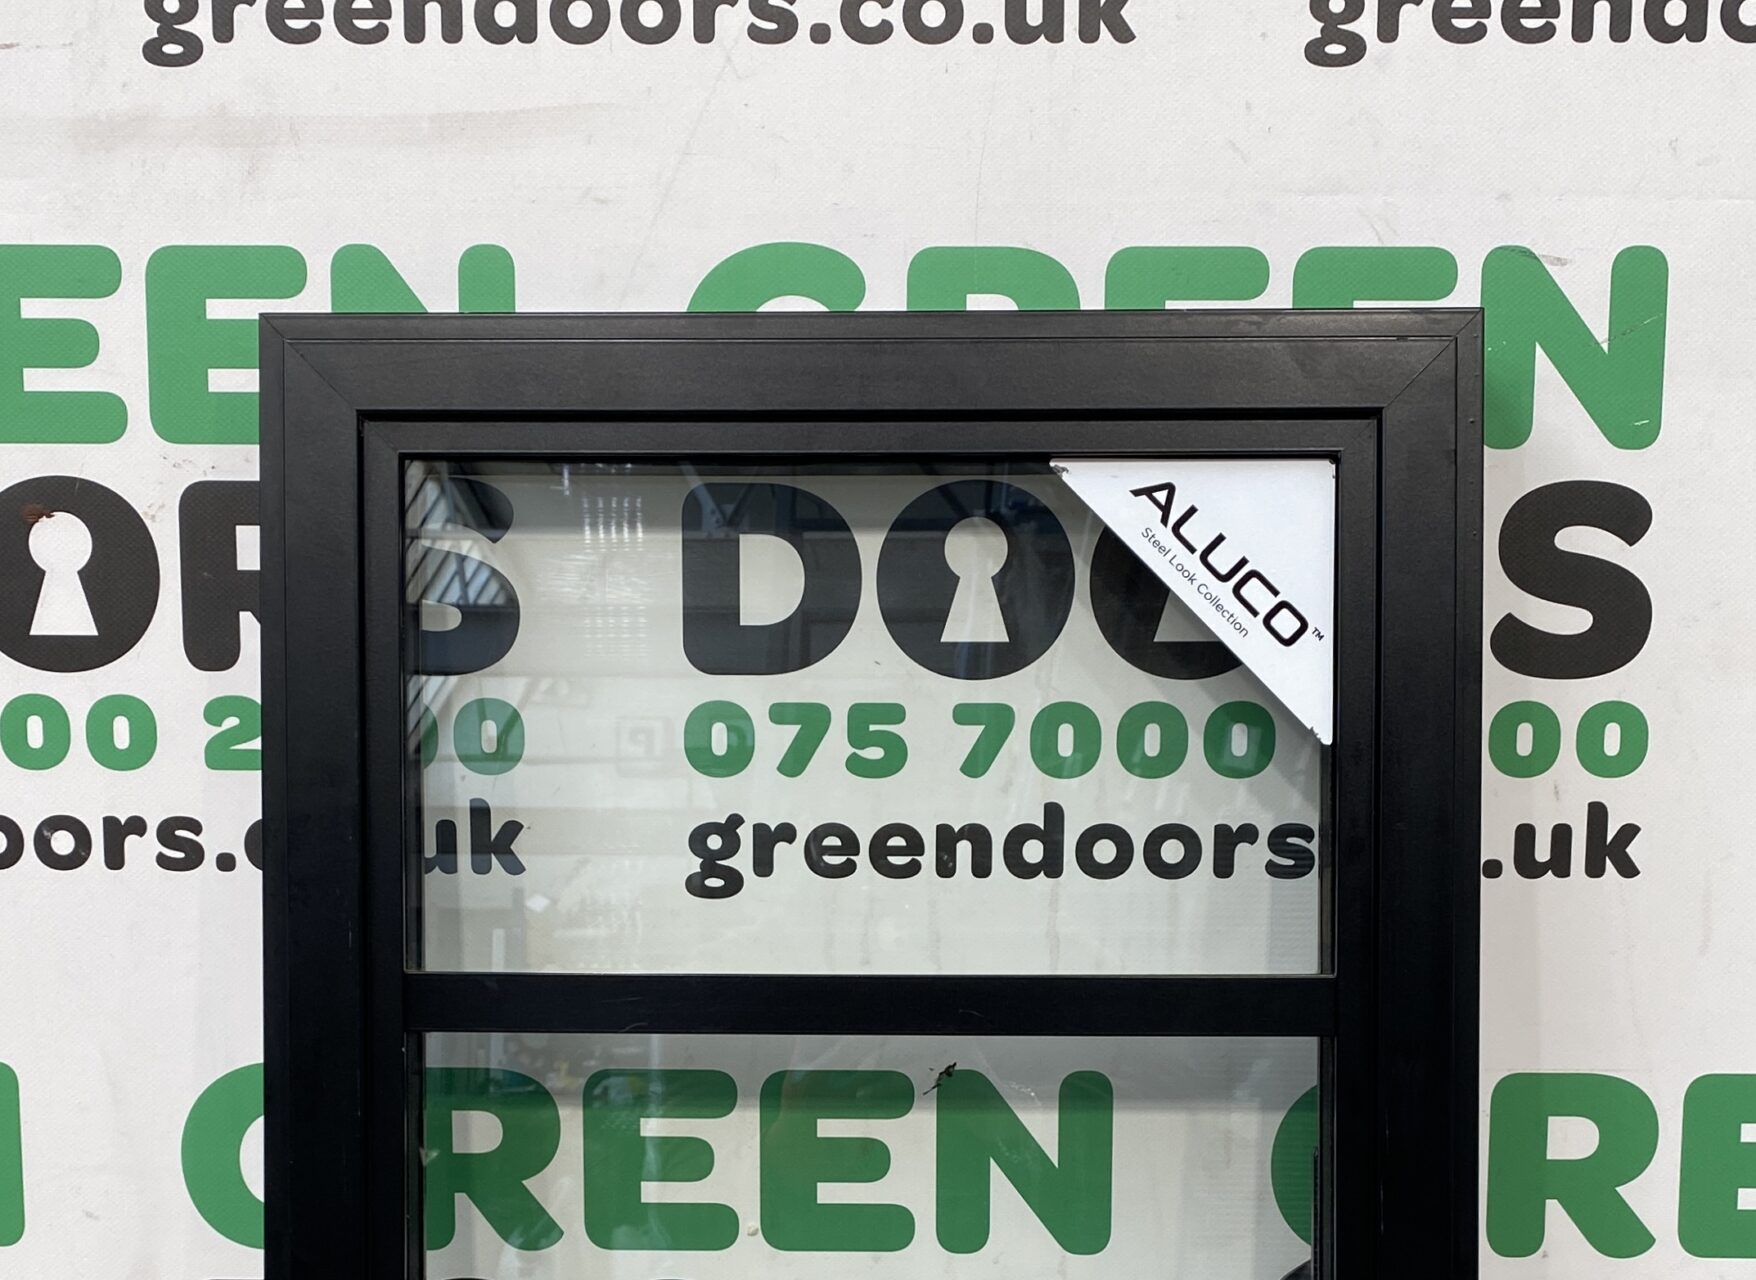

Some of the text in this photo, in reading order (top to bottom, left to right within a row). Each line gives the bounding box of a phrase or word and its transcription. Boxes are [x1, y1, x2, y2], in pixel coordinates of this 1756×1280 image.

[142, 0, 1137, 67] greendoors.co.uk
[1141, 527, 1249, 638] Steel Look Collection
[684, 700, 908, 778] 075
[952, 701, 1276, 779] 7000
